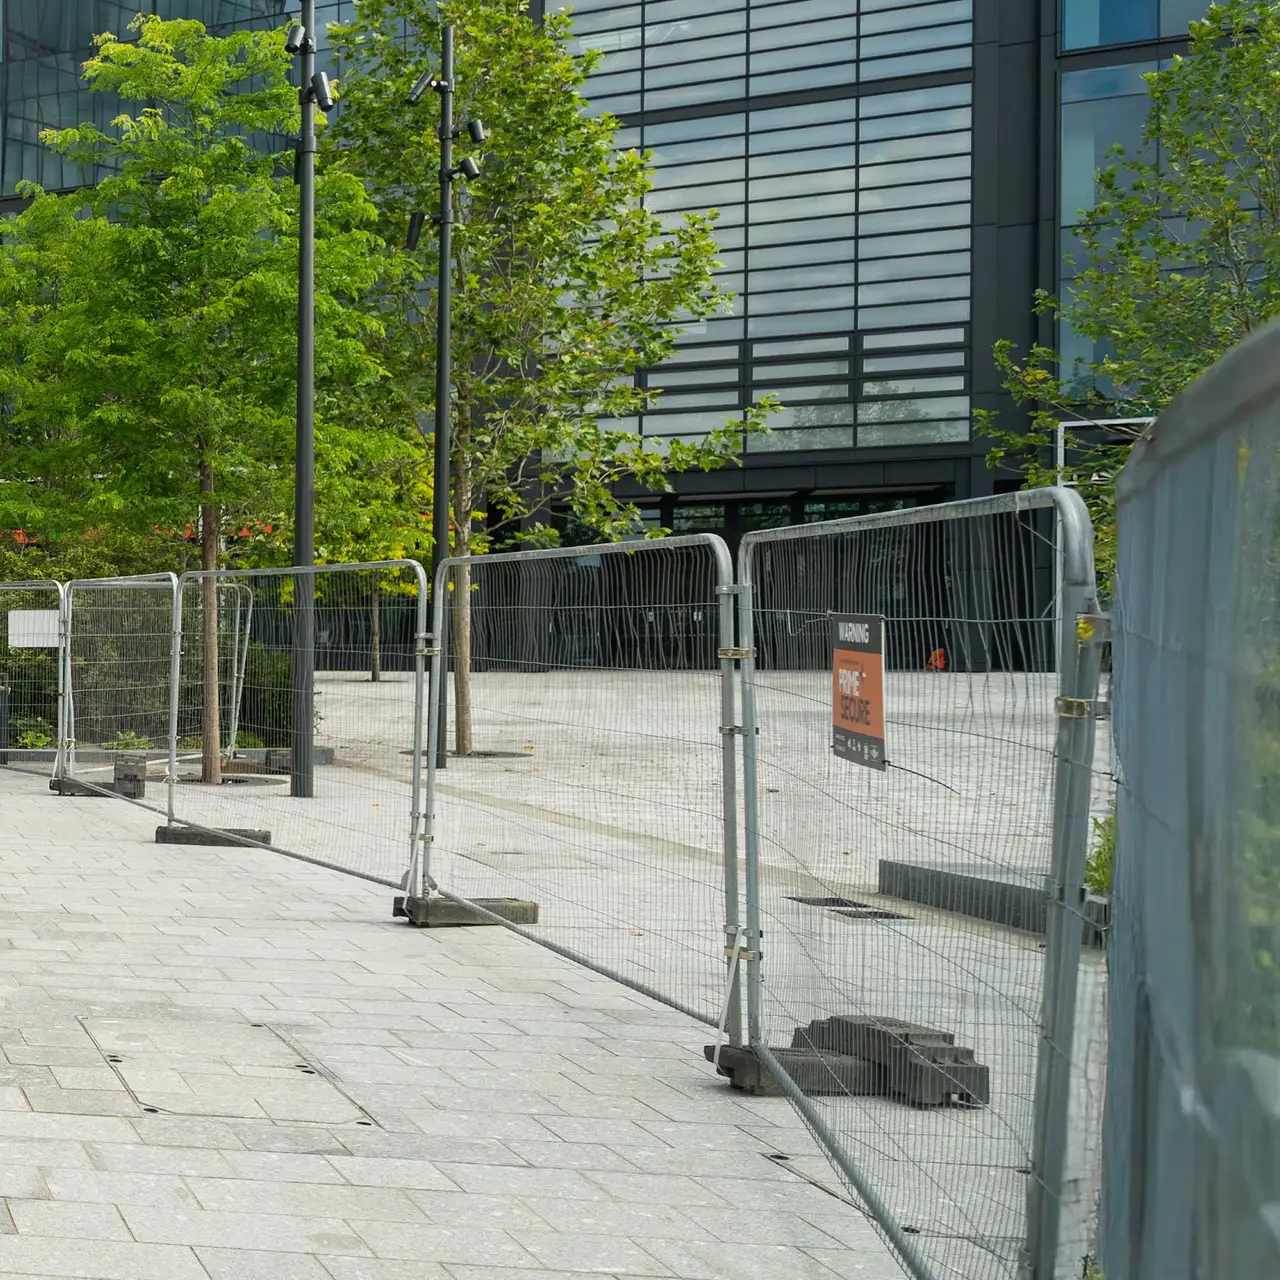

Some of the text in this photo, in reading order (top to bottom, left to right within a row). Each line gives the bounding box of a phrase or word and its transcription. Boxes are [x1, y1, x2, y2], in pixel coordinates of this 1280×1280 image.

[838, 621, 870, 644] WARNING
[838, 668, 860, 697] PRIME
[840, 694, 871, 726] SECURE
